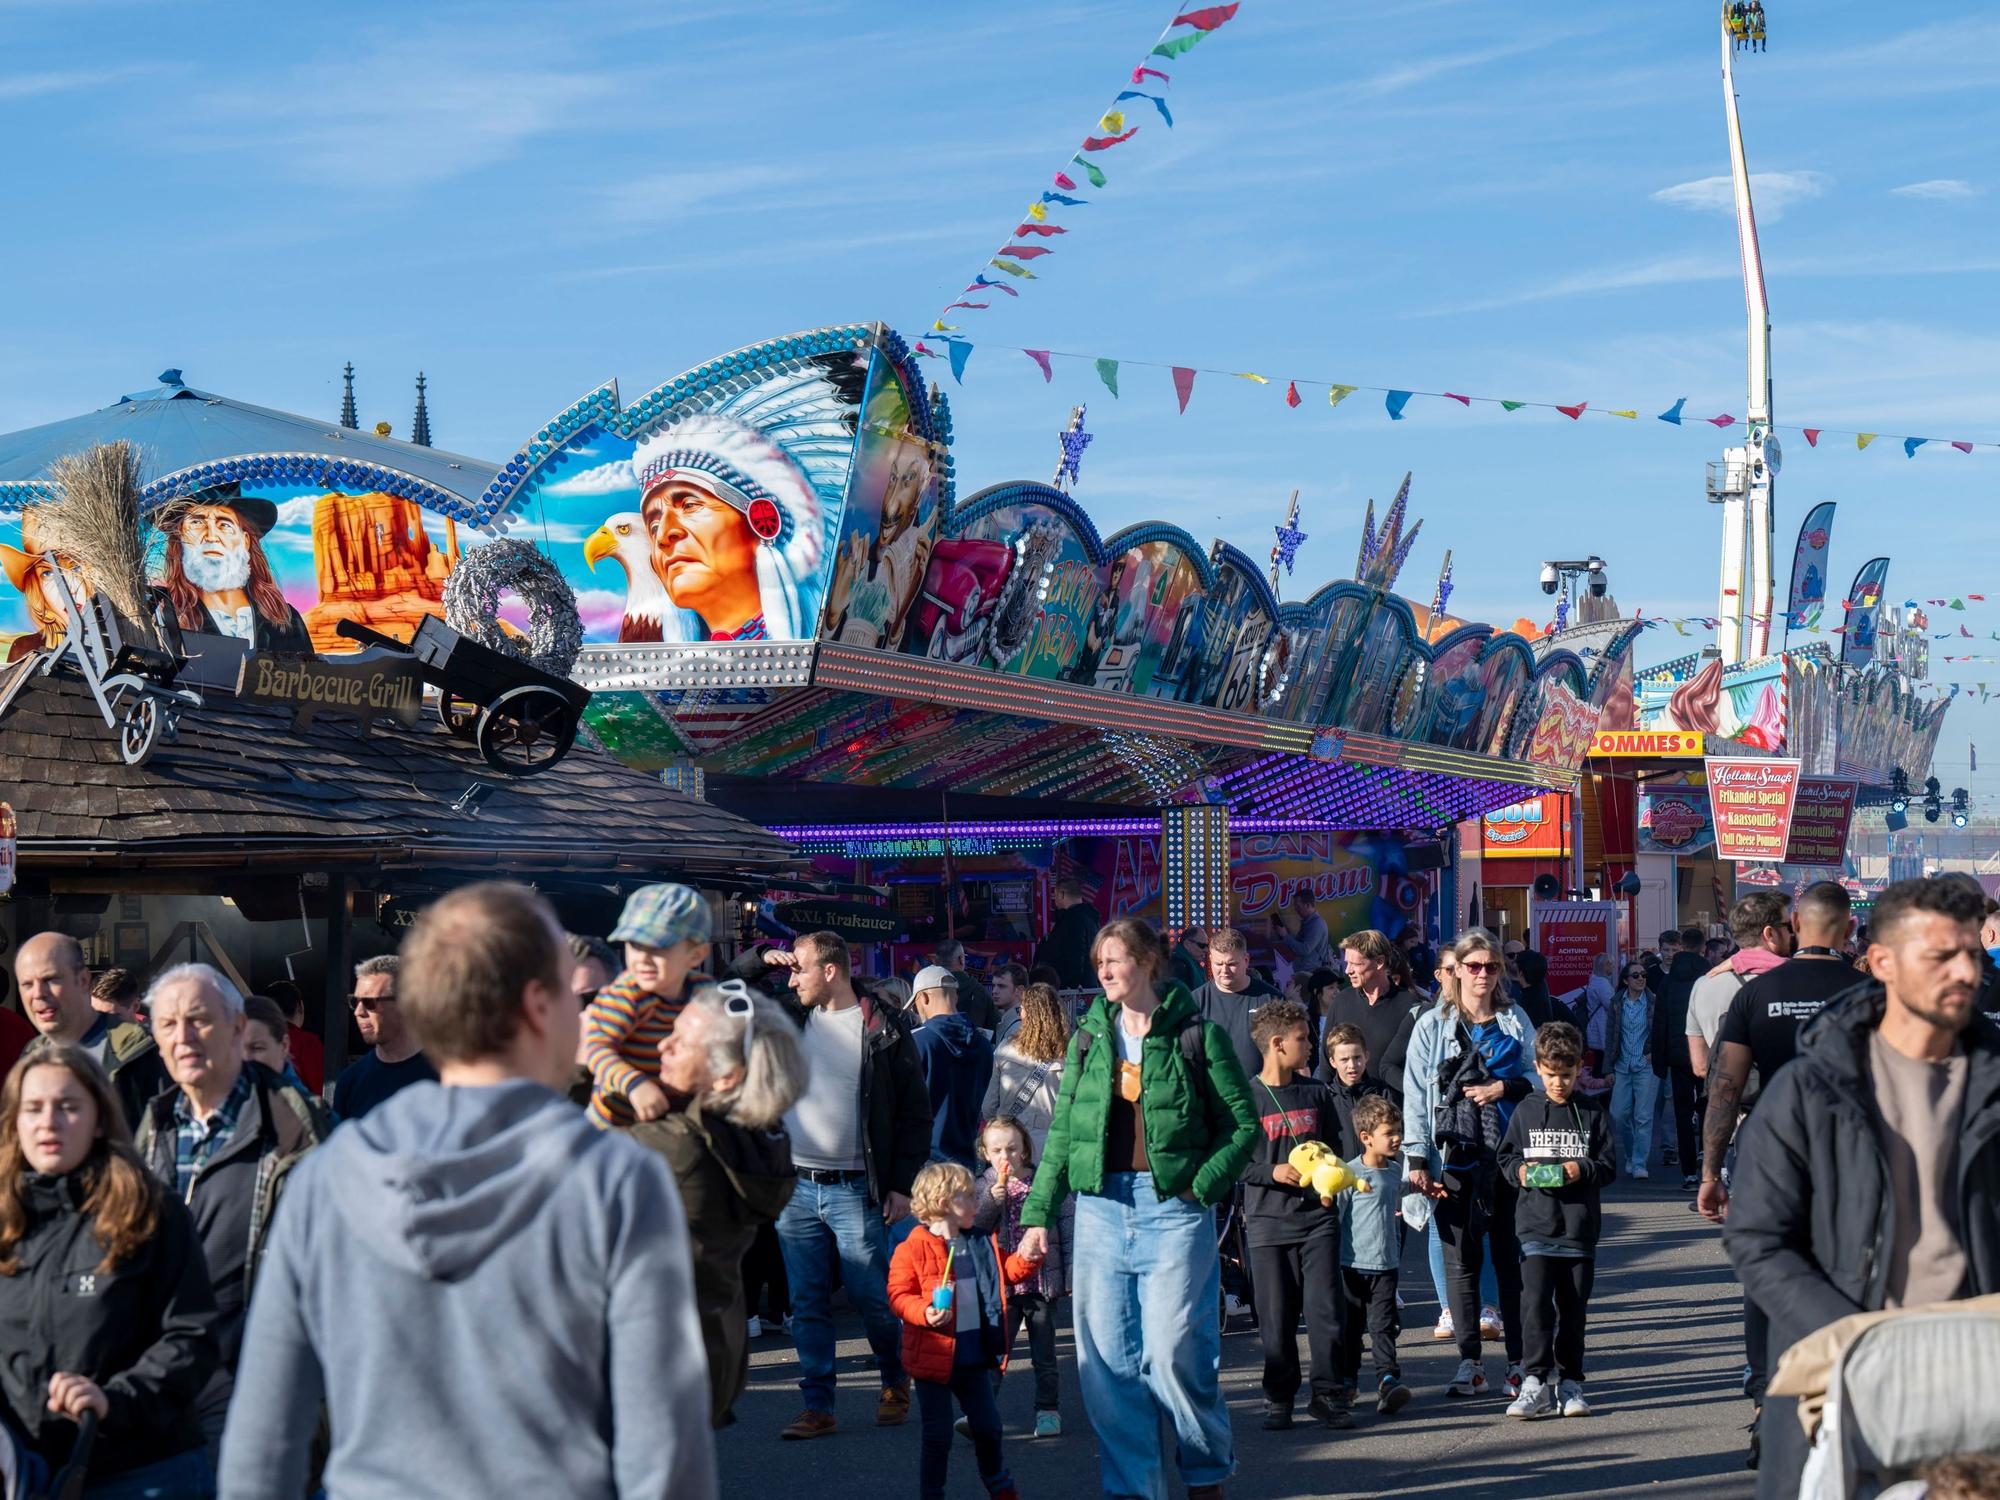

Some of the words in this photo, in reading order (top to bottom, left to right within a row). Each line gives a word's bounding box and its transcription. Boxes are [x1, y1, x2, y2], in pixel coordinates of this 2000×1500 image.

[255, 659, 413, 710] Barbecue-Grill
[1713, 766, 1758, 785] Holland
[1757, 767, 1793, 786] Snack
[1719, 790, 1756, 804] Frikandel
[1758, 791, 1786, 805] Spezial
[1818, 784, 1851, 800] Snack
[1486, 800, 1543, 822] ood
[1794, 805, 1818, 817] kandel
[1819, 806, 1844, 819] Spezial
[1486, 827, 1528, 842] Spezial
[1736, 834, 1756, 846] Cheese
[1756, 834, 1781, 847] Pommes
[1234, 865, 1373, 915] Dream
[791, 909, 822, 924] XXL
[826, 911, 896, 931] Krakauer
